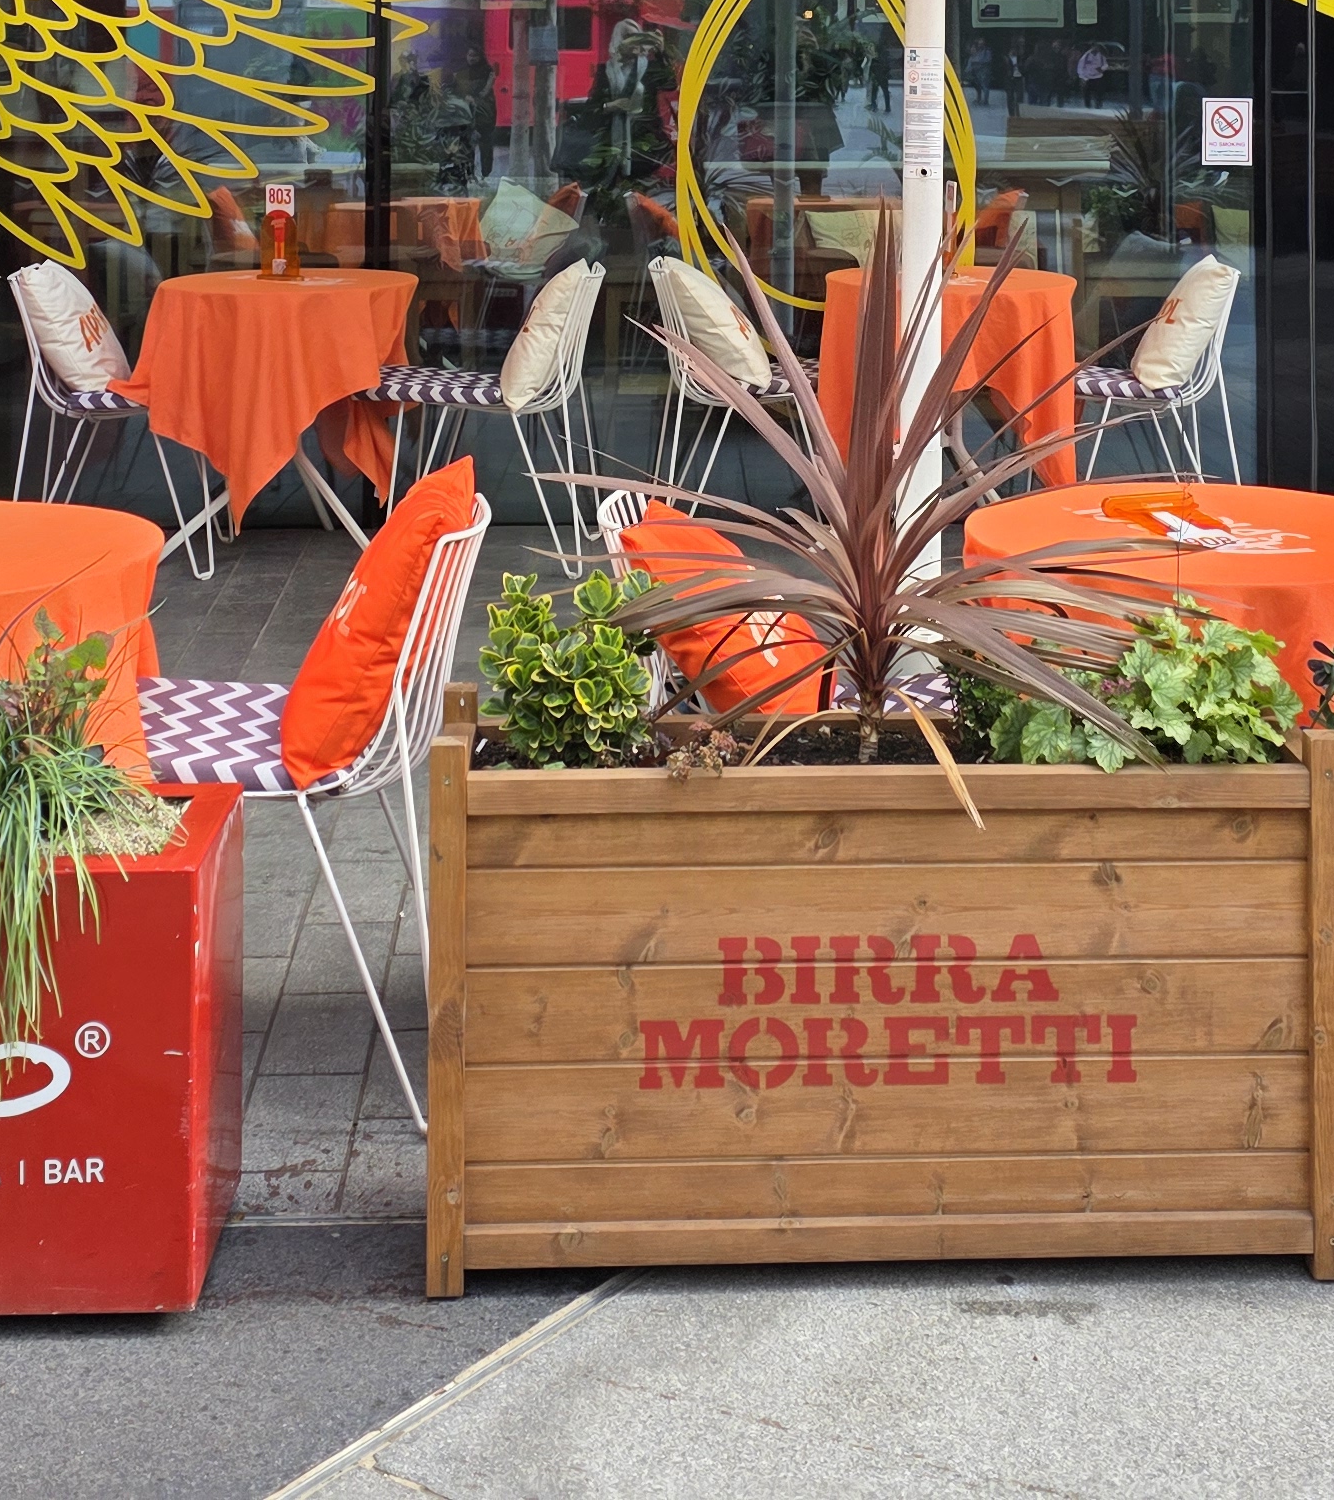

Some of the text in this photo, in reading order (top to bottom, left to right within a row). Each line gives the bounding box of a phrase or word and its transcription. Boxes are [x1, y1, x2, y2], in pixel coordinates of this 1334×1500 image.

[268, 187, 292, 205] 803
[716, 933, 1060, 1006] BIRRA
[637, 1014, 1138, 1091] MORETTI
[43, 1157, 105, 1187] BAR
